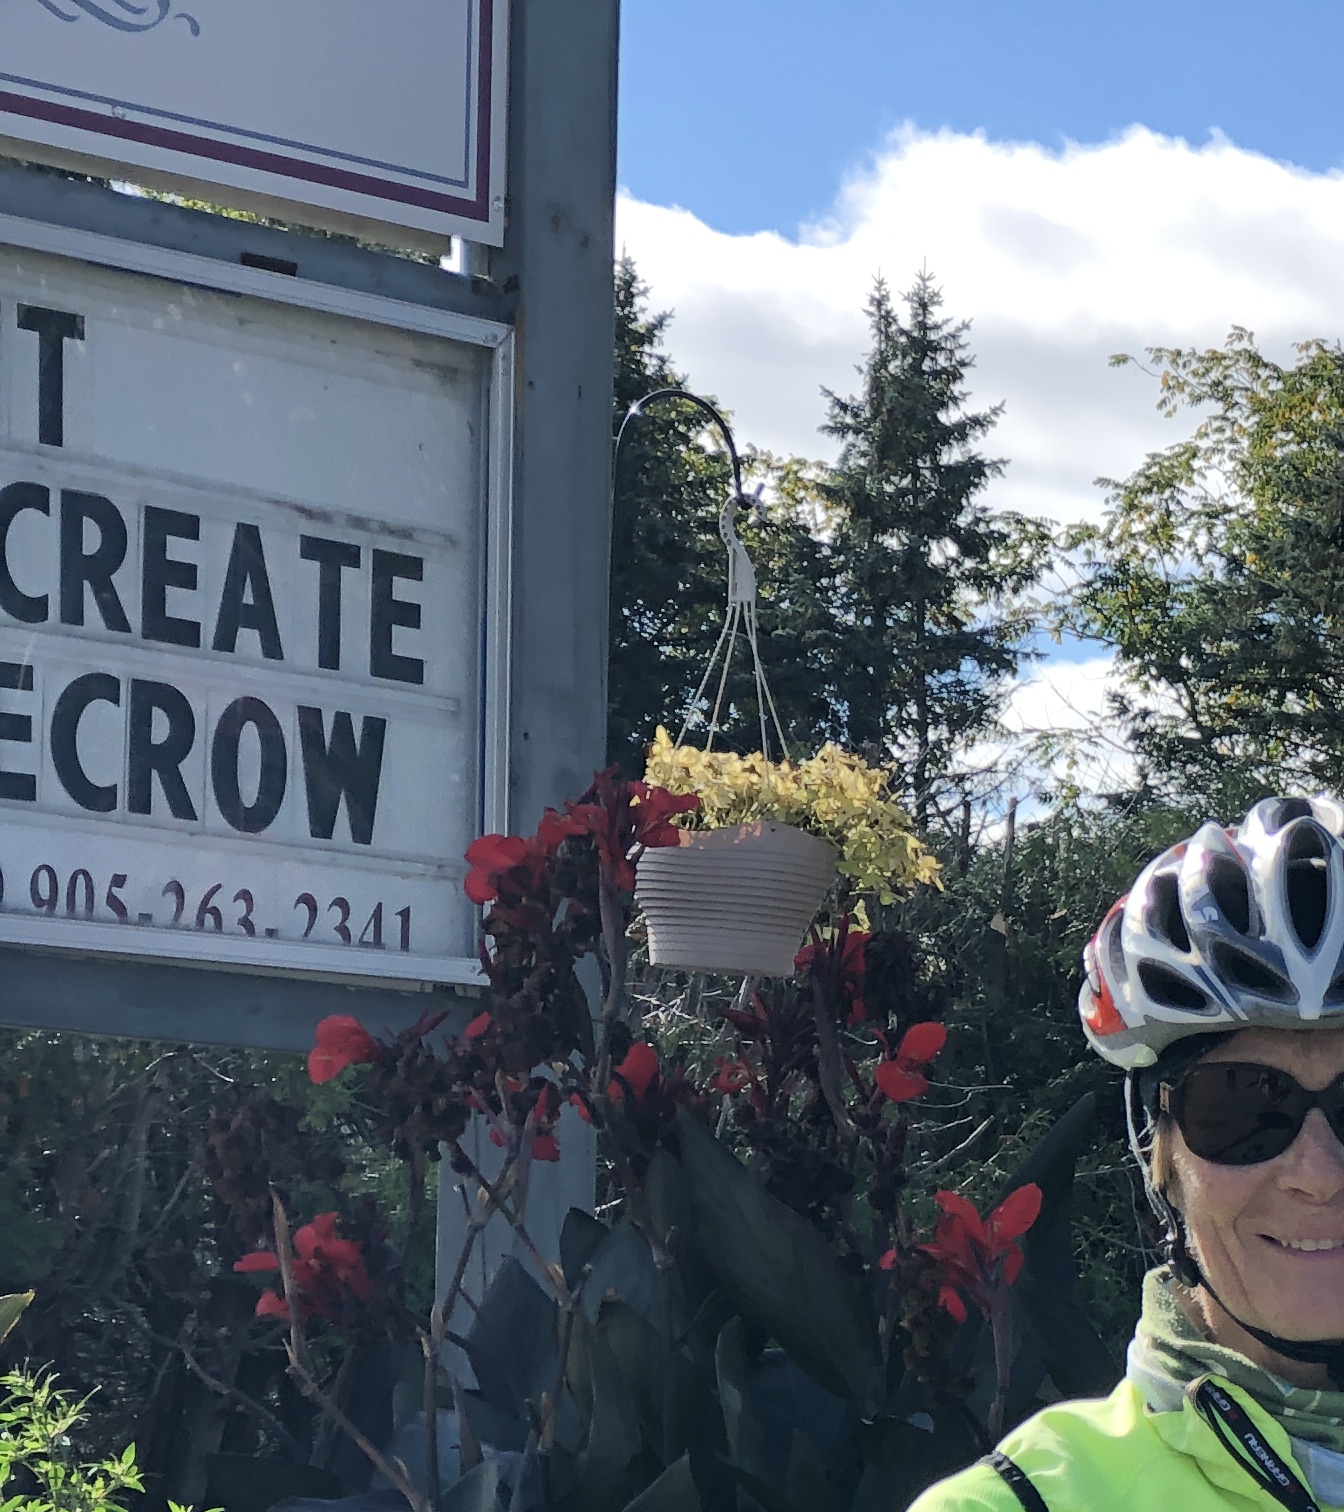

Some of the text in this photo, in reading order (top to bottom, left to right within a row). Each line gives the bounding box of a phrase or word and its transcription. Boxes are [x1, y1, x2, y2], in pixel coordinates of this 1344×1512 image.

[0, 300, 85, 448] T
[0, 480, 425, 685] CREATE
[1244, 1432, 1291, 1487] GARNEAU
